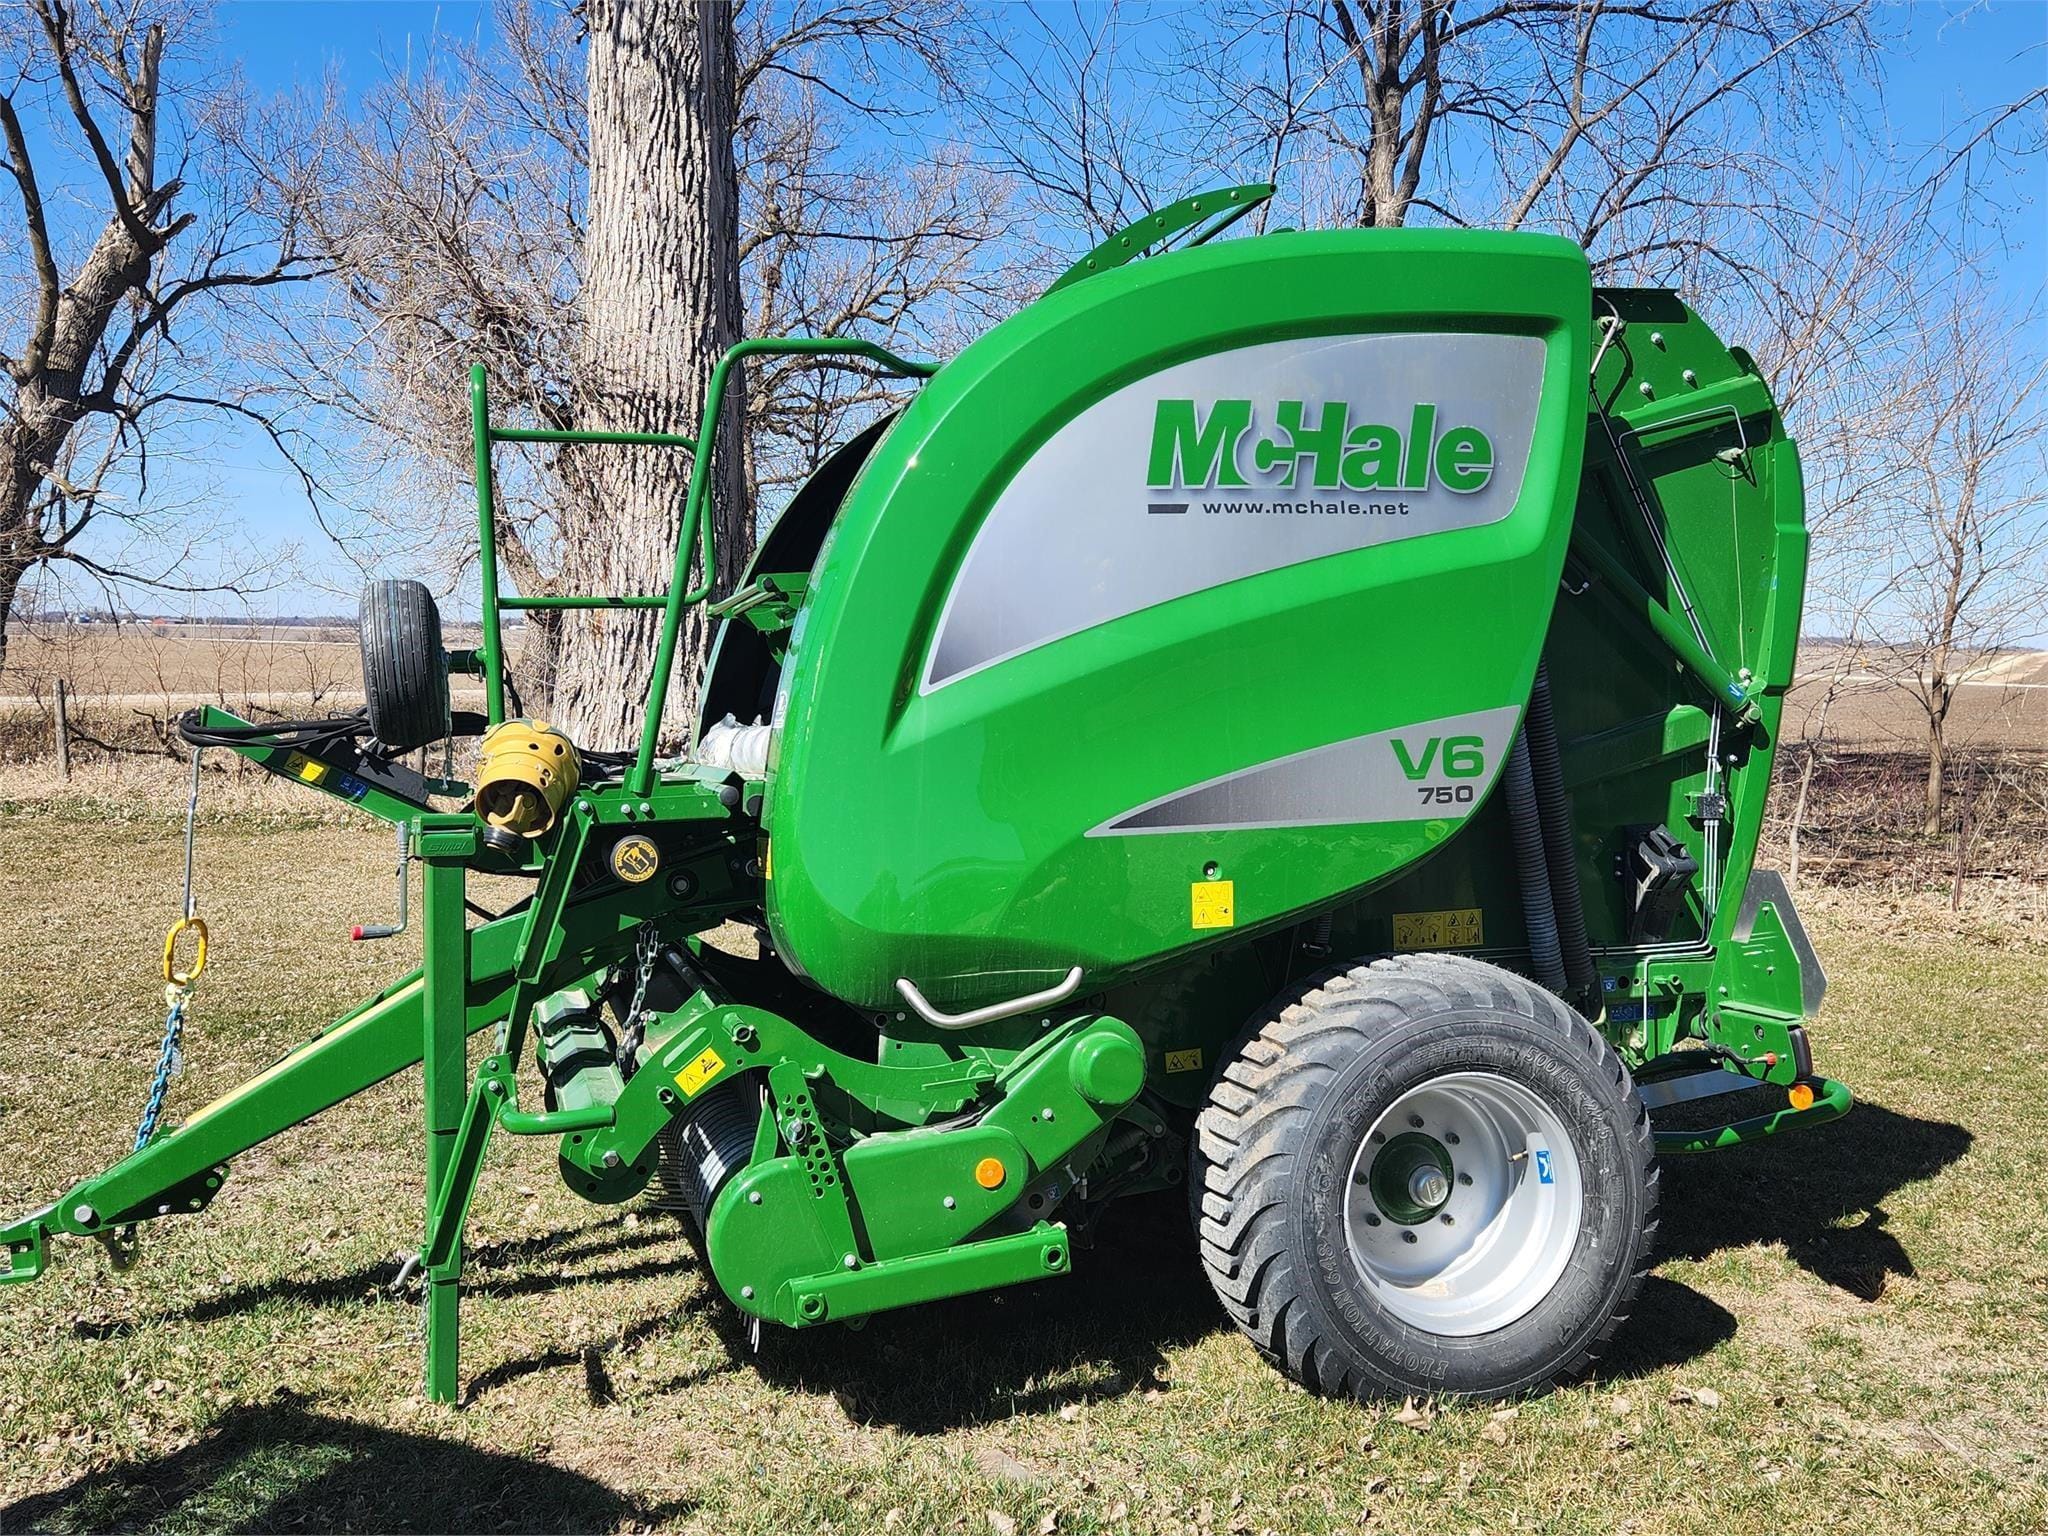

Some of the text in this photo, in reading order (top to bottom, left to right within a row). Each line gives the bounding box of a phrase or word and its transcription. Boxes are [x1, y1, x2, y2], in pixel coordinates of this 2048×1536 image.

[1146, 399, 1495, 493] McHale
[1202, 499, 1410, 516] www.mchale.net
[1389, 735, 1485, 780] V6
[1417, 784, 1474, 805] 750
[1331, 1287, 1449, 1380] FLOTATION
